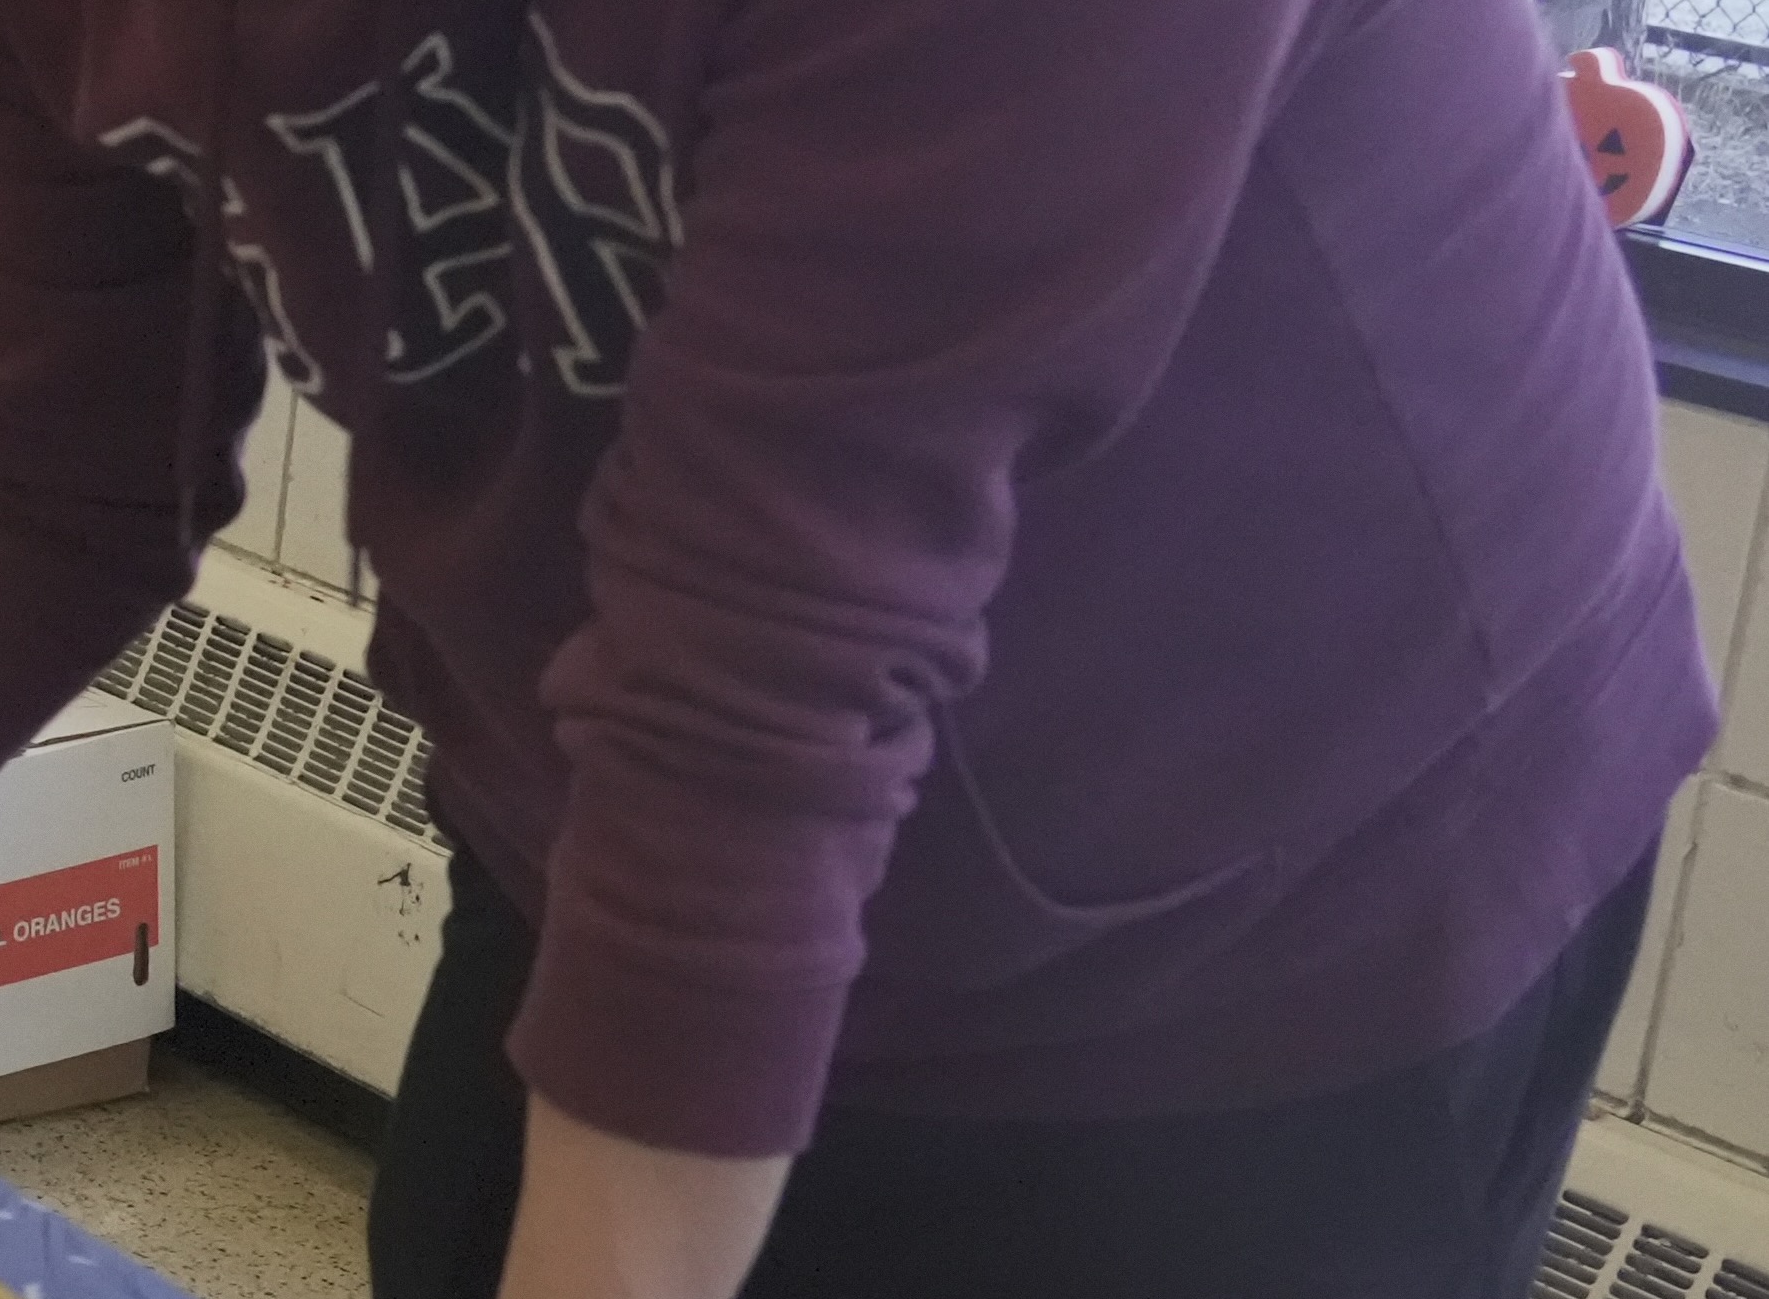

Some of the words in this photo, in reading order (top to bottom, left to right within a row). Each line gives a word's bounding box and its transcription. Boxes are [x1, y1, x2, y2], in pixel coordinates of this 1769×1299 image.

[121, 764, 156, 782] COUNT
[118, 854, 140, 870] ITEM
[13, 897, 121, 942] ORANGES
